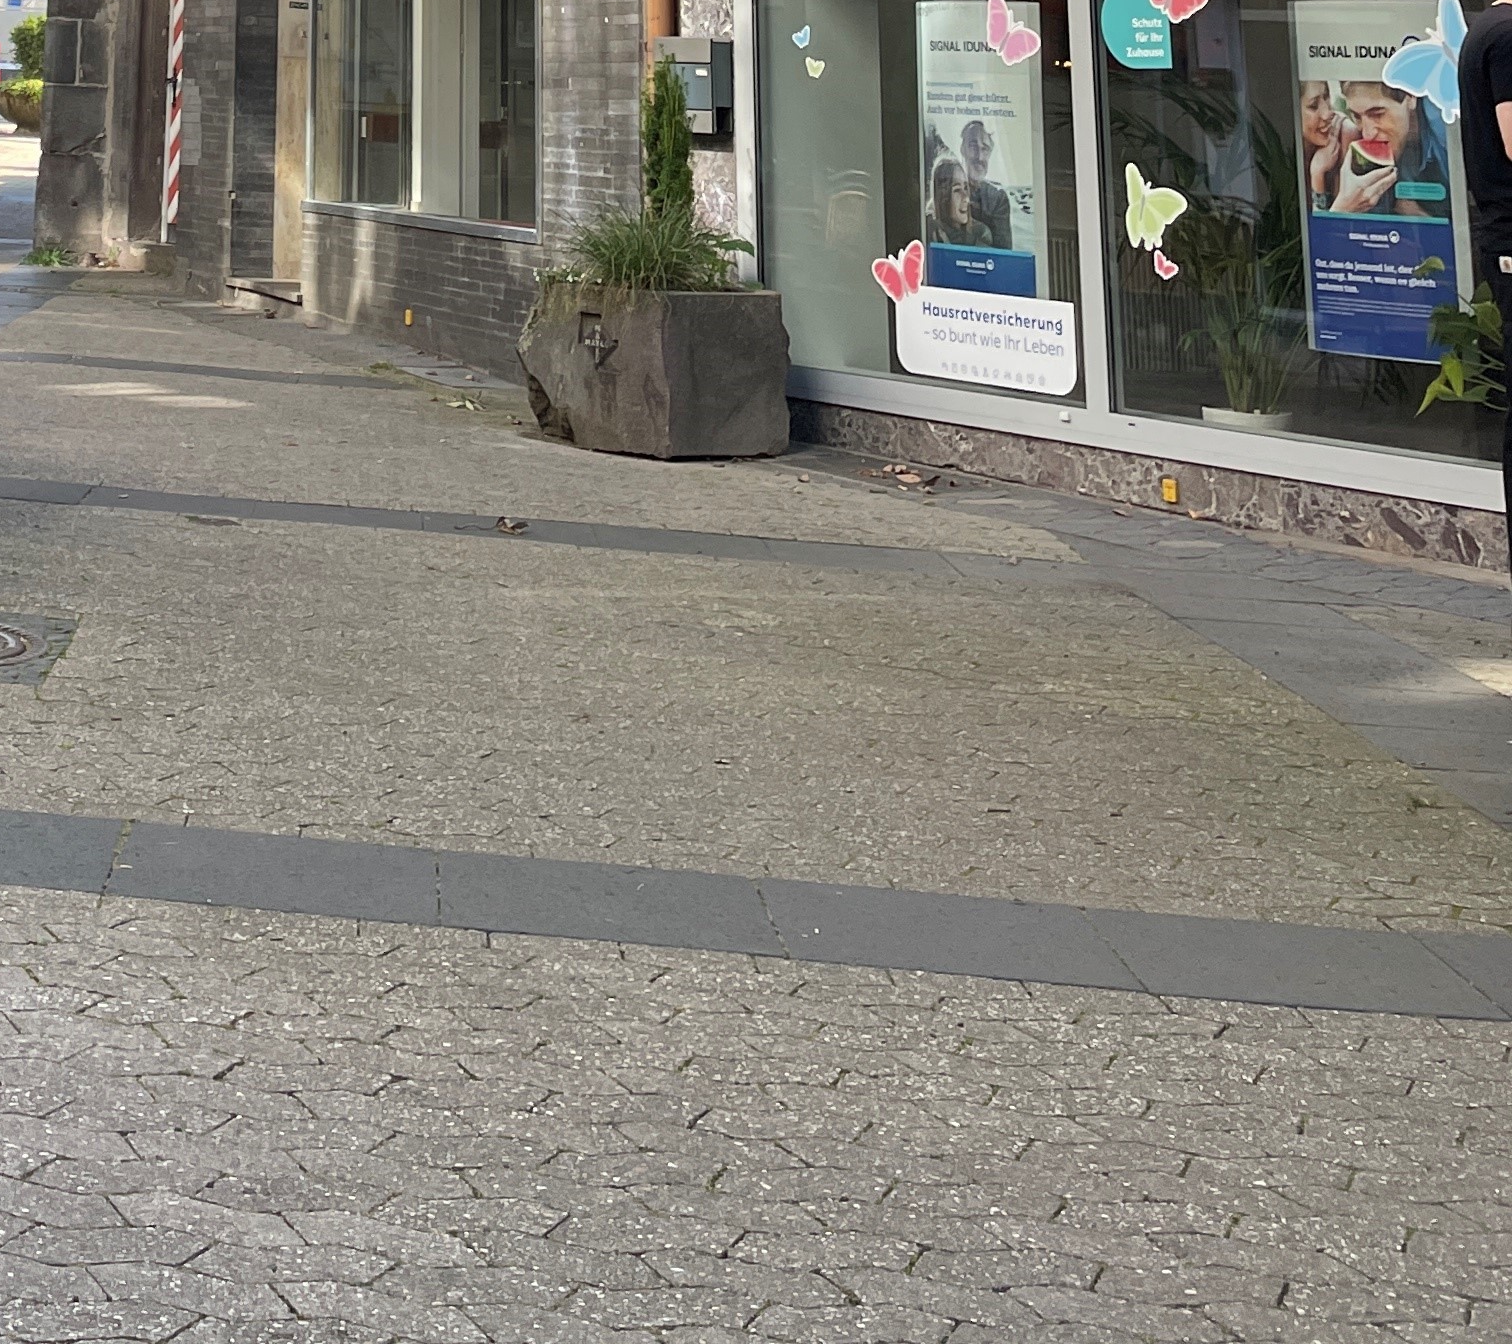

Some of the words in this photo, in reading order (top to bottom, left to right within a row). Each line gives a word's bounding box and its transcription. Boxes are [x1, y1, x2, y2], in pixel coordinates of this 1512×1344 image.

[1131, 17, 1163, 28] Schutz
[930, 40, 961, 52] SIGNAL
[1308, 45, 1352, 58] SIGNAL
[1126, 47, 1165, 58] Zuhause
[922, 302, 1064, 335] Hausratversicherung
[932, 328, 947, 341] so
[950, 327, 978, 346] bunt
[980, 333, 1002, 349] wie
[1004, 336, 1021, 352] Ihr
[1024, 337, 1065, 358] Leben
